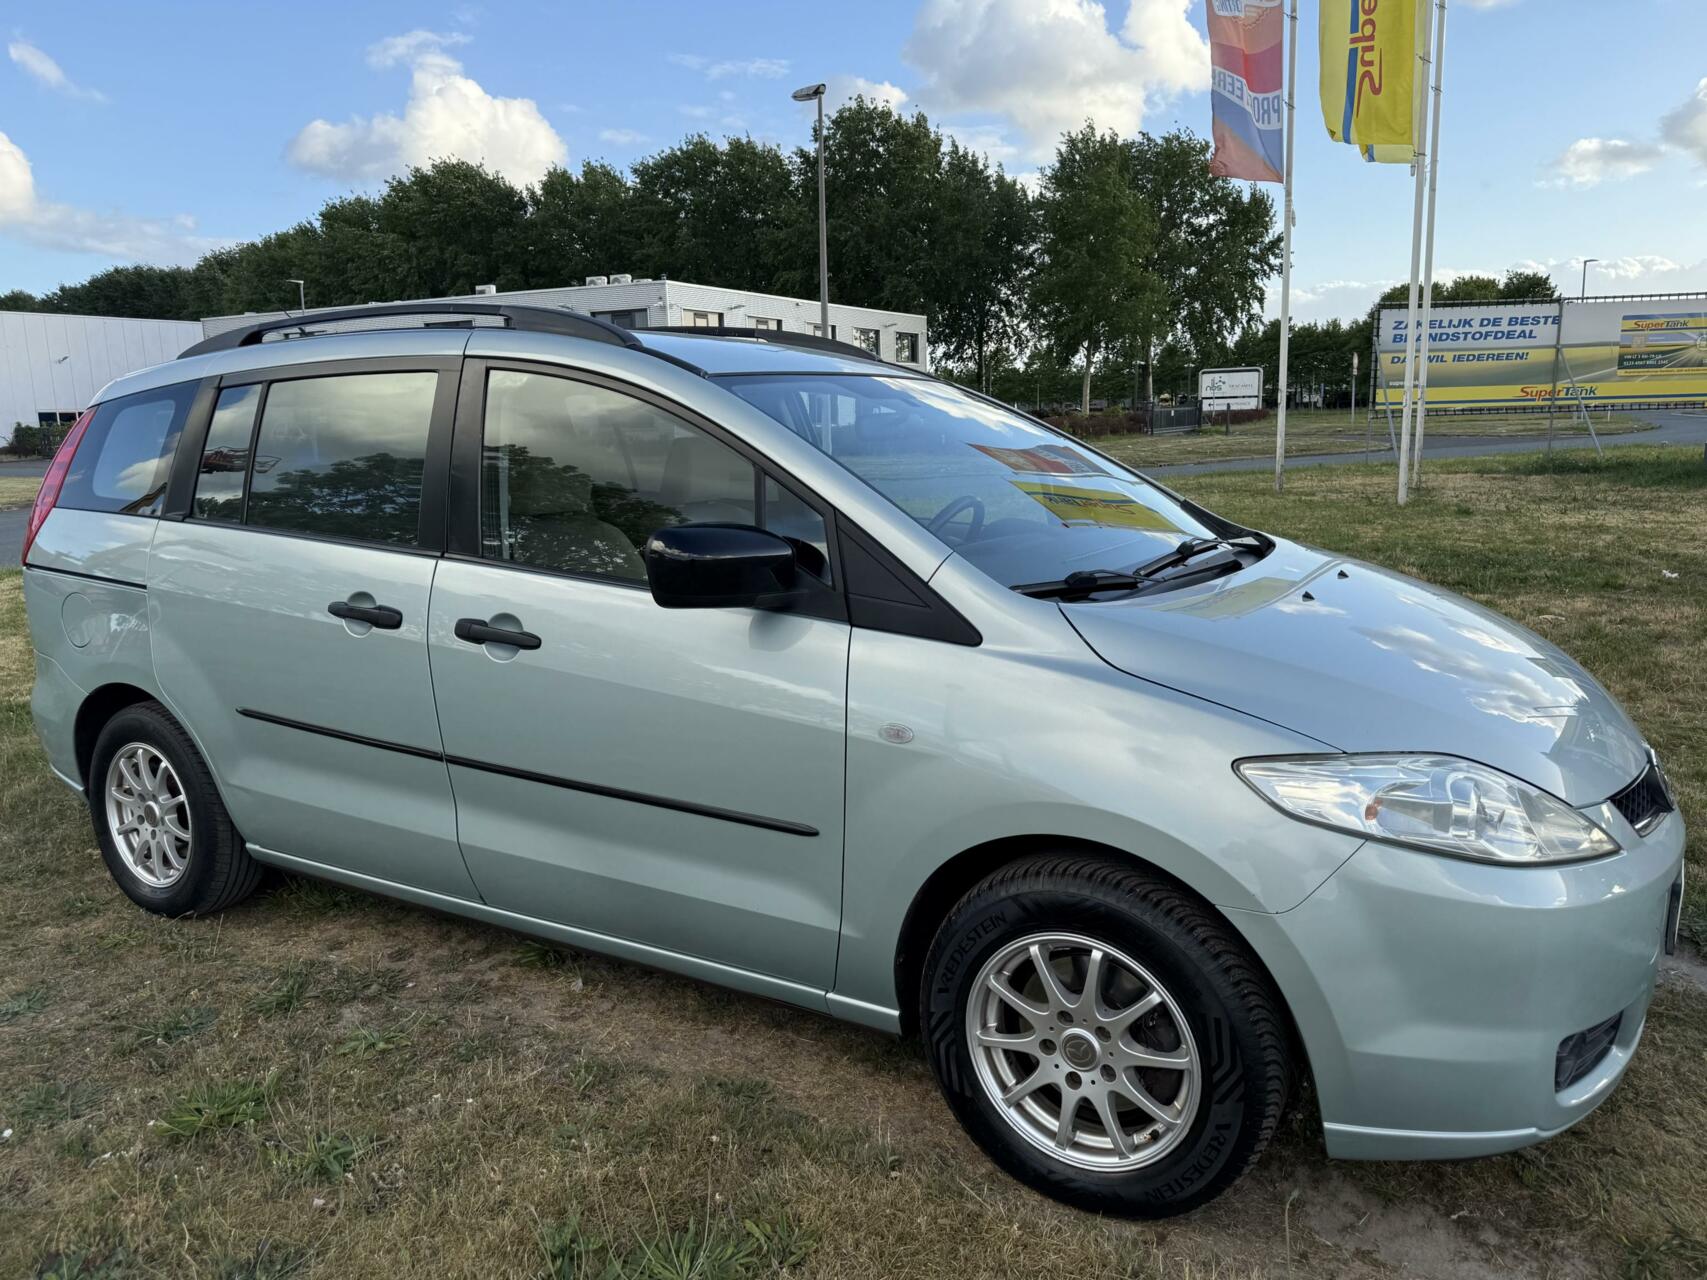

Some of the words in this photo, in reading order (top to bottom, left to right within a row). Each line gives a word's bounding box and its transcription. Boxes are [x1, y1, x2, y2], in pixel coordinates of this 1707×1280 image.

[1480, 317, 1503, 328] DE
[1507, 315, 1561, 327] BESTE
[1633, 320, 1689, 330] SuperTank
[1452, 352, 1529, 363] IEDEREEN!
[1514, 386, 1597, 401] SuperTank
[937, 910, 1008, 994] VREDESTEIN
[1144, 1123, 1232, 1201] VREDESTEIN
